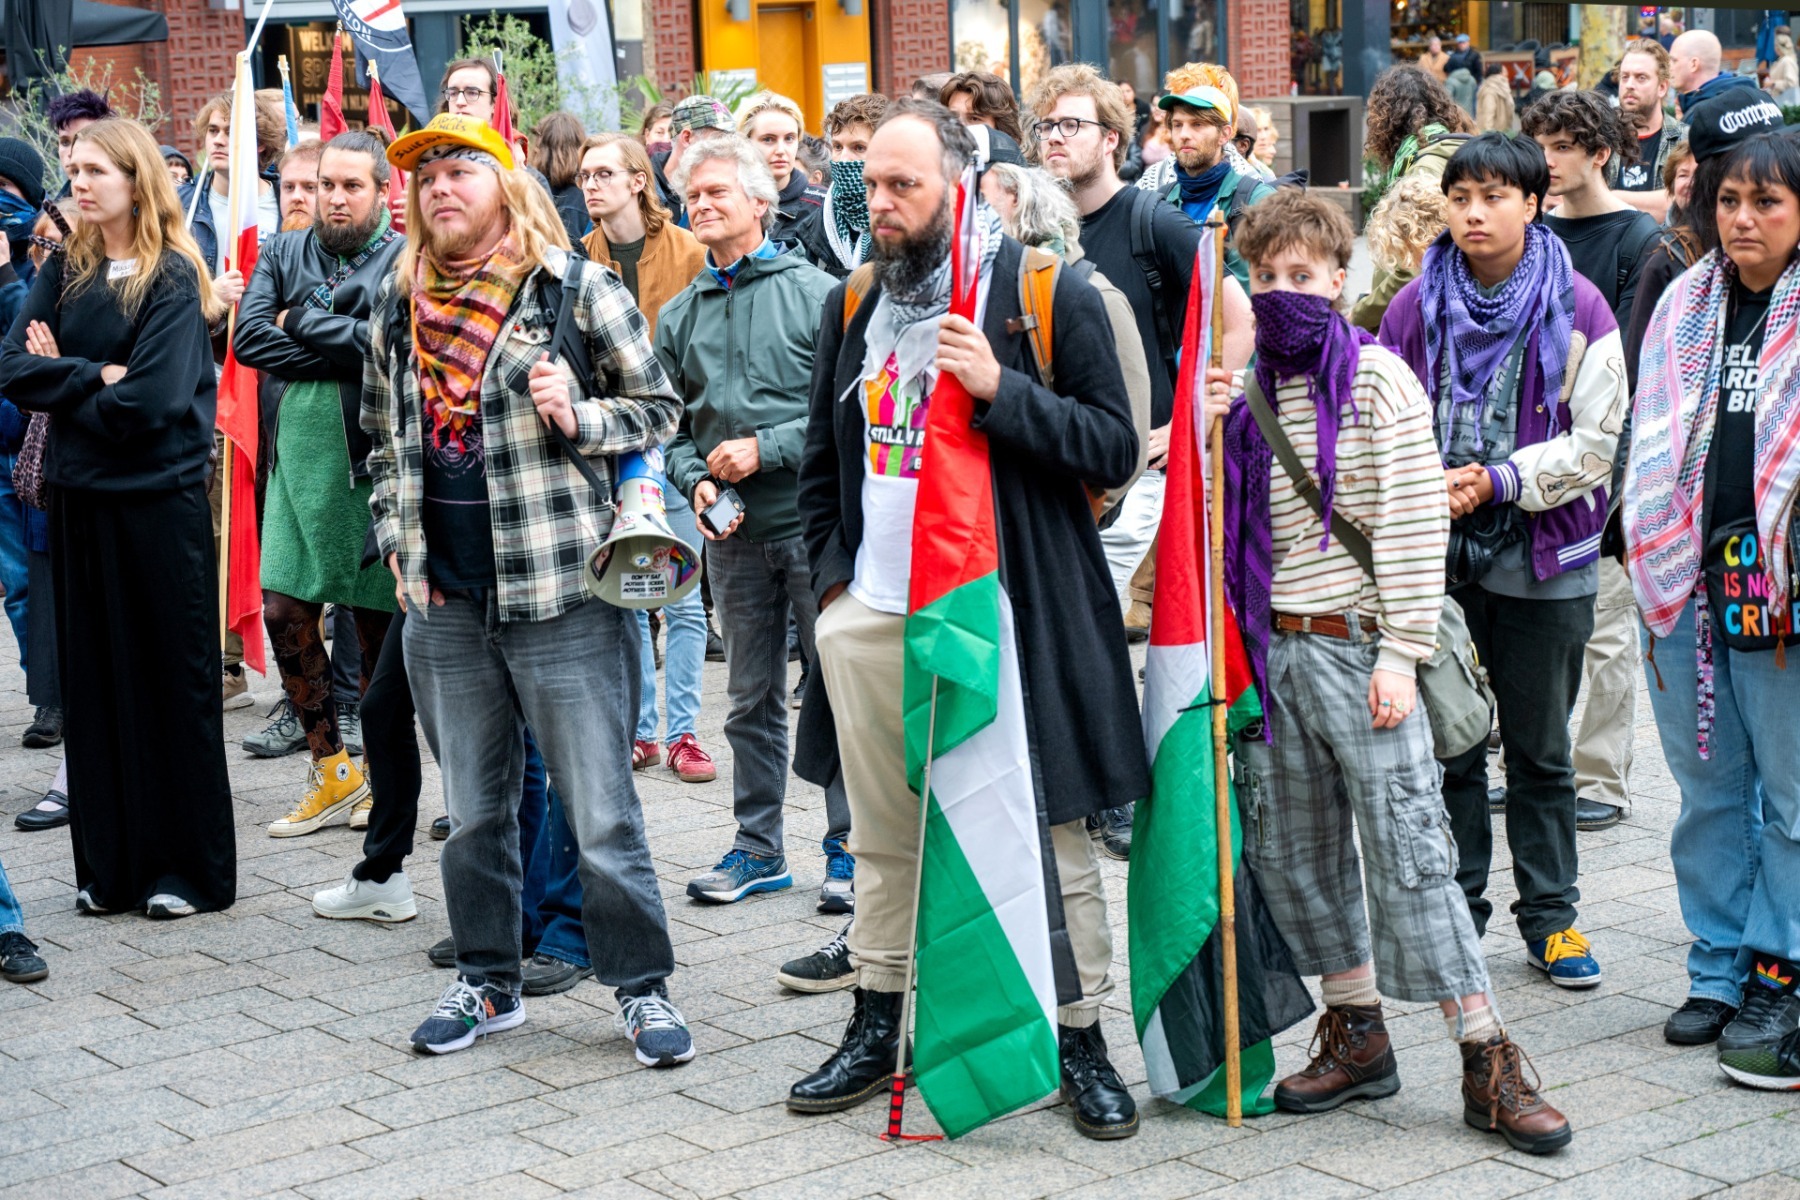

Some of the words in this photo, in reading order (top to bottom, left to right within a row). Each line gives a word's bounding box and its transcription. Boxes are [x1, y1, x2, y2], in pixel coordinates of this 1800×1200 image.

[298, 31, 353, 52] WELKM
[870, 427, 904, 444] STILL
[1724, 572, 1741, 598] IS
